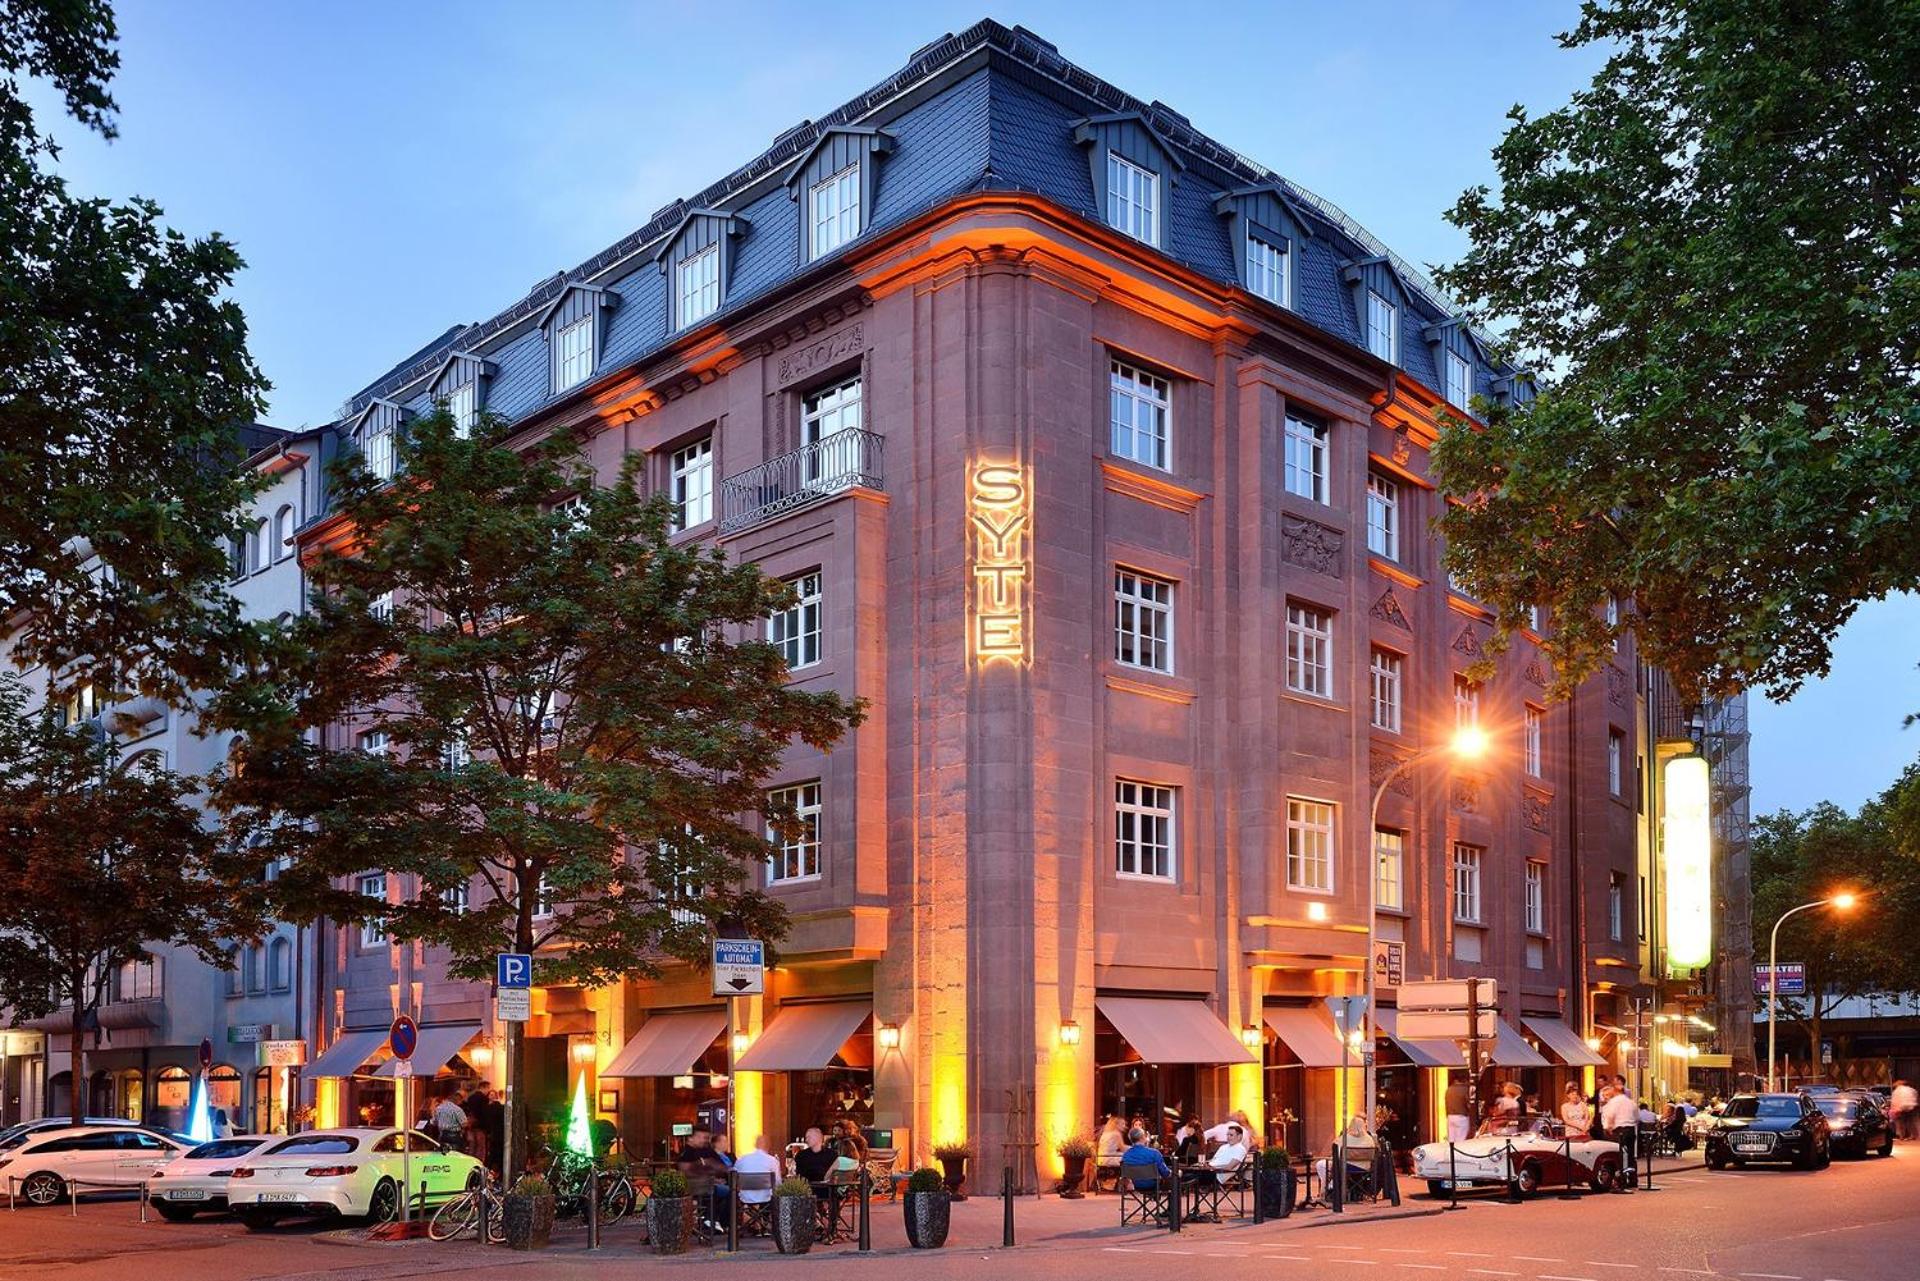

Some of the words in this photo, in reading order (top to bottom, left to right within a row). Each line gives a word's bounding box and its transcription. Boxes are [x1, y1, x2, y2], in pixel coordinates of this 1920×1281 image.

[972, 465, 1027, 655] SYTE
[716, 943, 760, 953] PARKSCHEIN-
[723, 953, 754, 963] AUTOMAT
[506, 959, 523, 983] P
